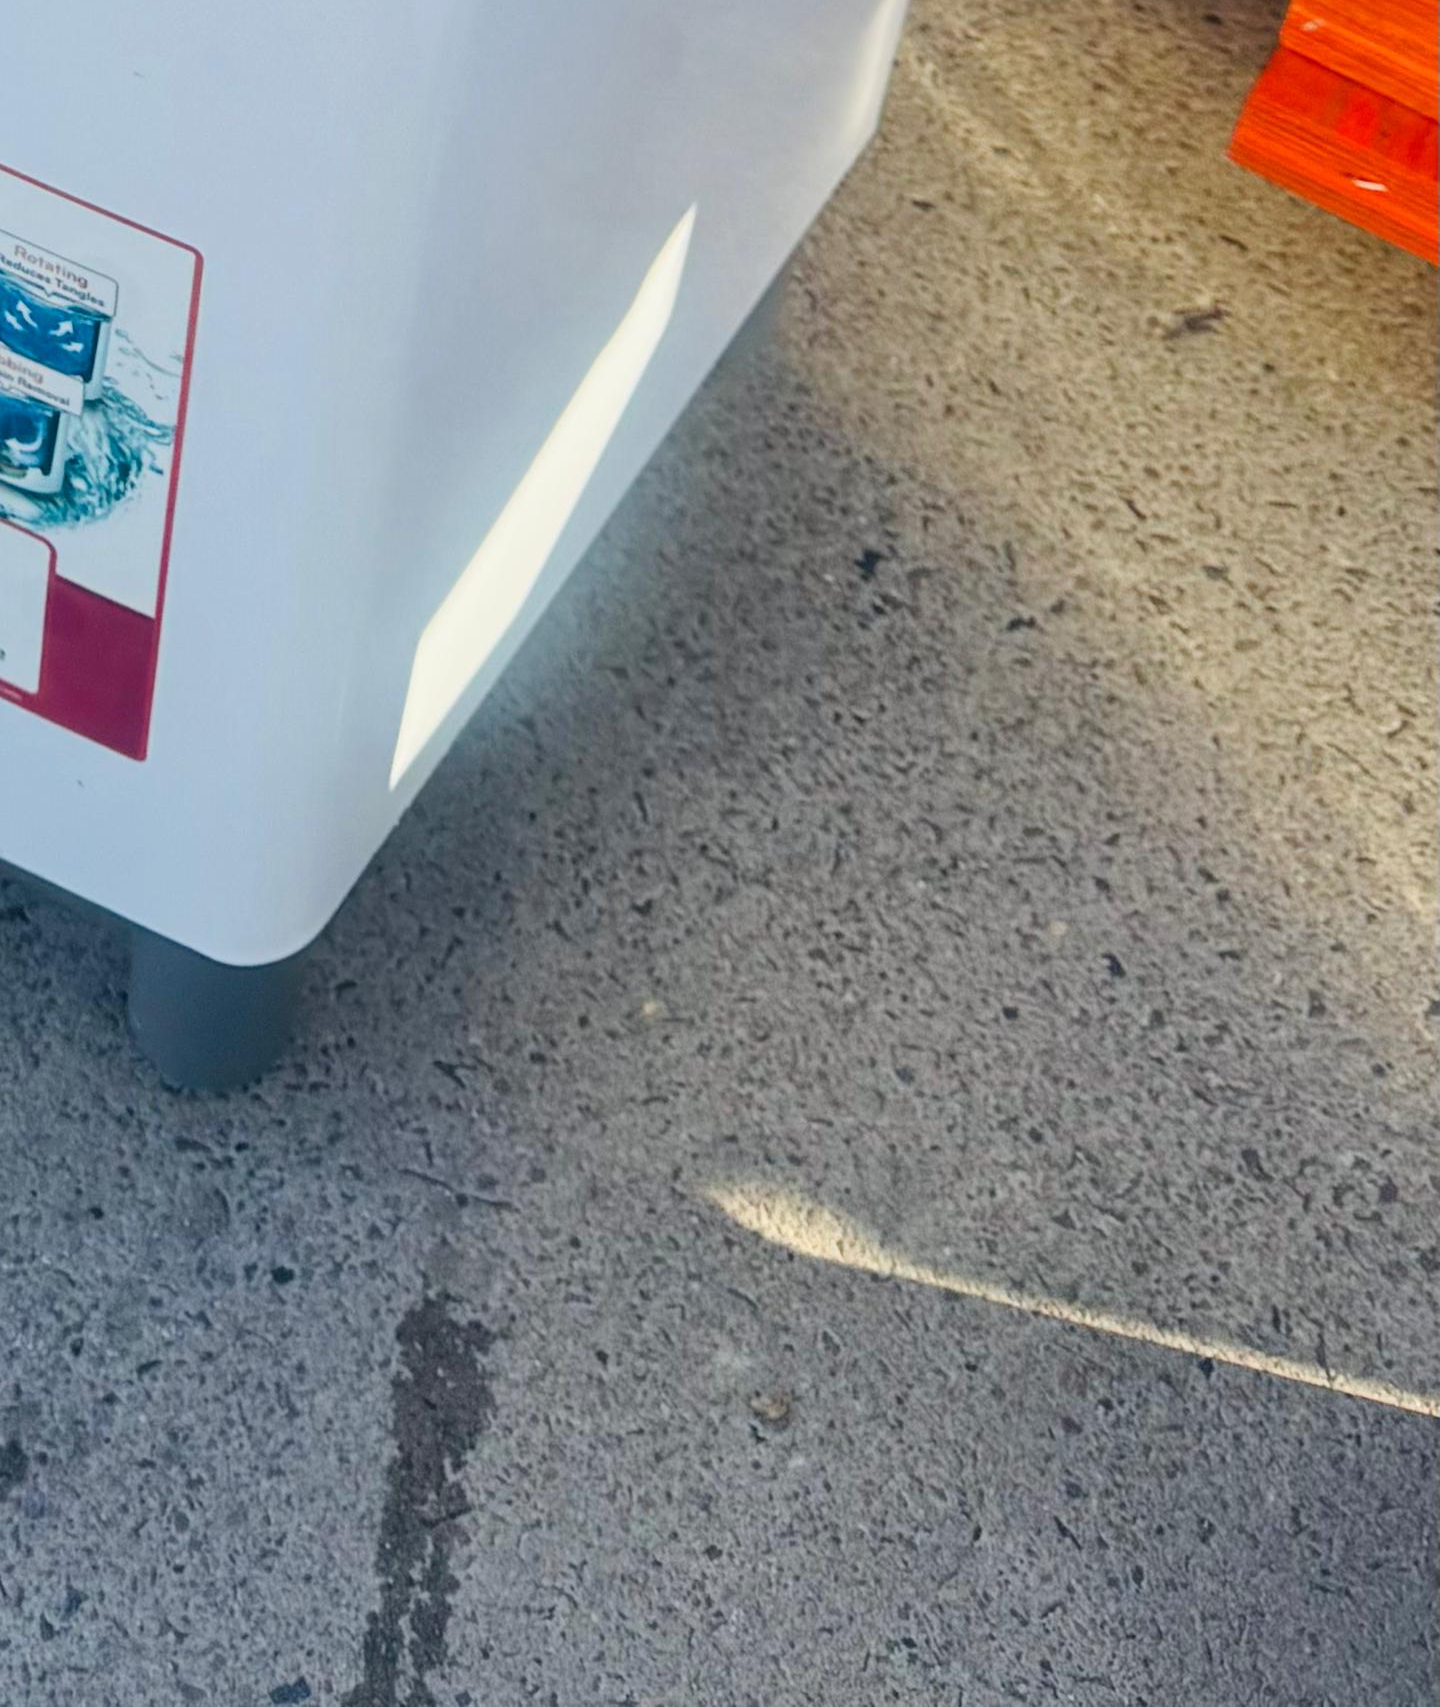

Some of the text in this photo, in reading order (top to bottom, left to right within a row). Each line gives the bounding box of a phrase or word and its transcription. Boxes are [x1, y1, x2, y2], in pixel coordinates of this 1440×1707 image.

[13, 243, 89, 290] Rotating
[53, 275, 106, 309] Tangles
[16, 375, 71, 407] Removal
